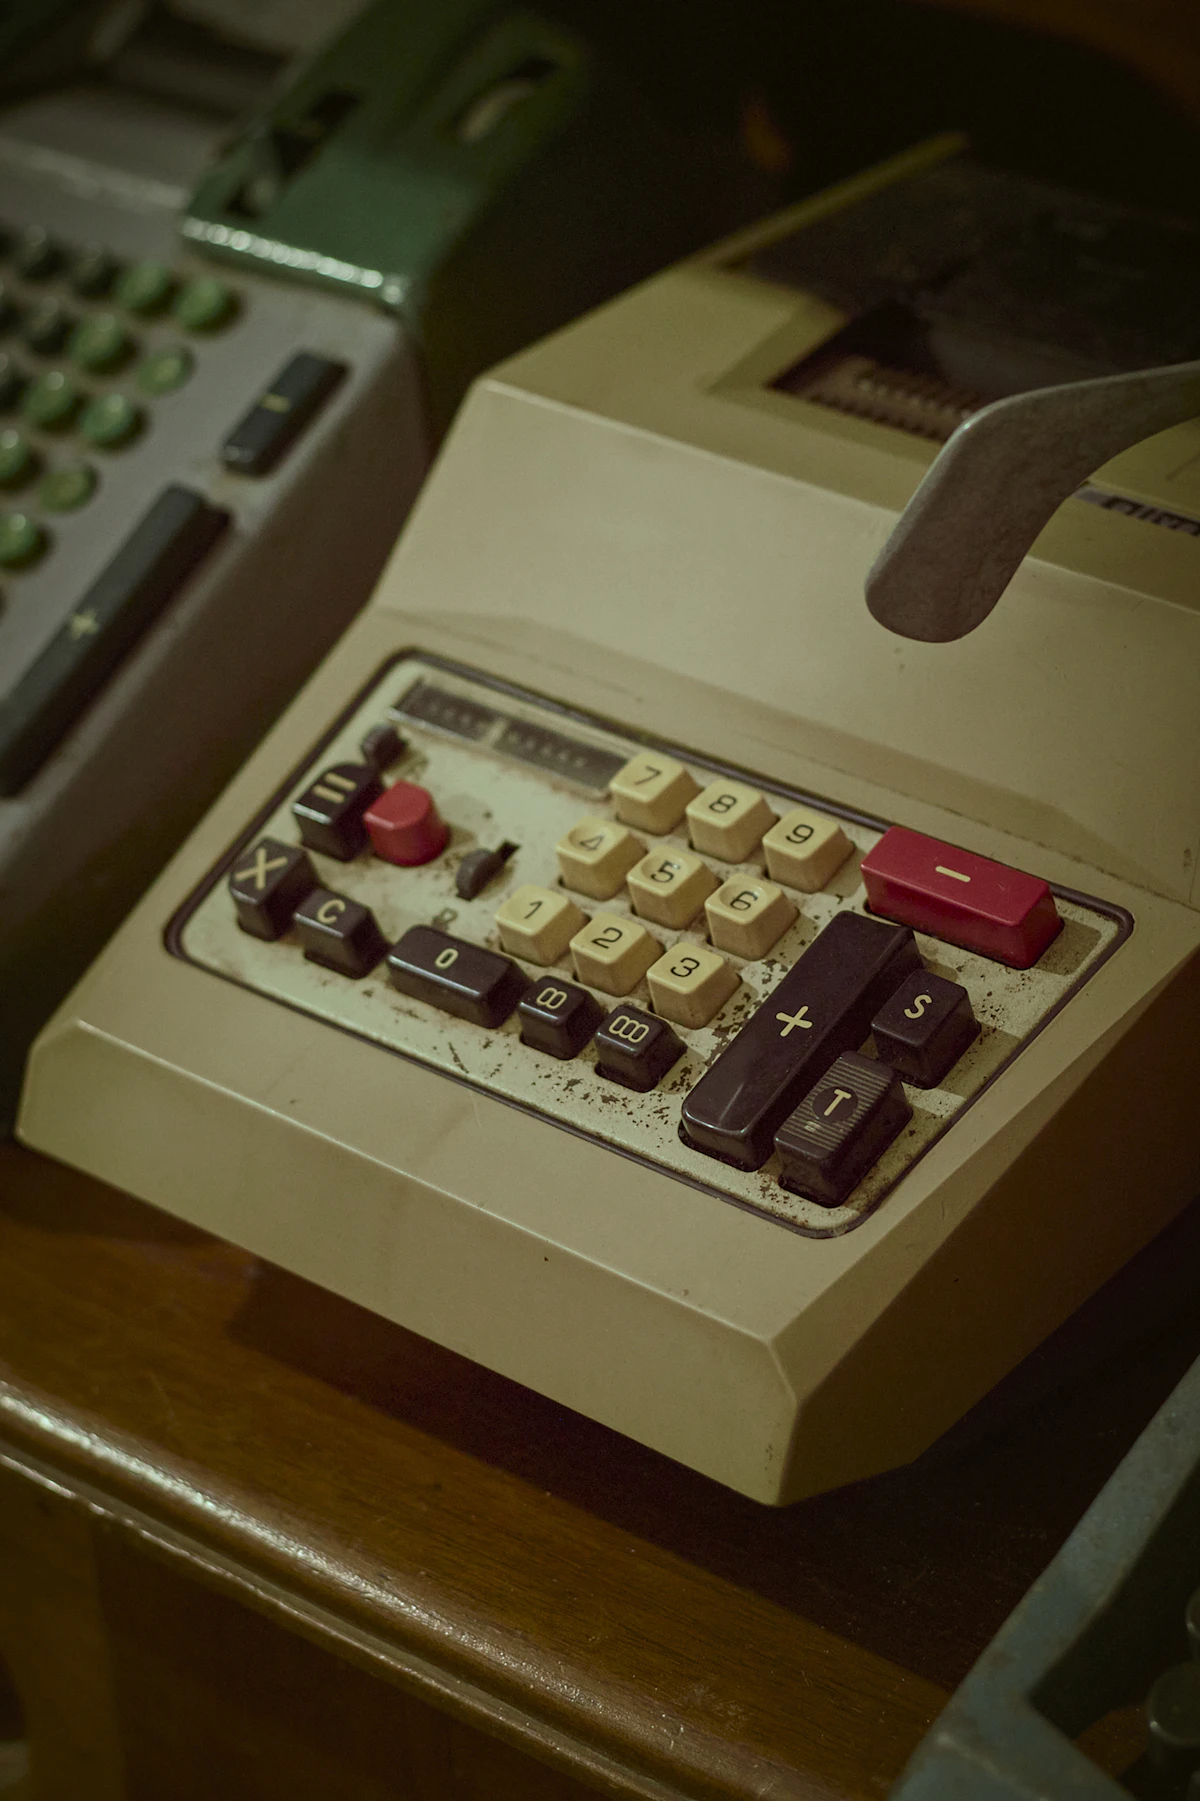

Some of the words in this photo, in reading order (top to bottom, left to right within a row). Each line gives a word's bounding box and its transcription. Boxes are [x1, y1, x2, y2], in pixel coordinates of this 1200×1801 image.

[634, 765, 662, 786] 7
[708, 794, 737, 814] 8
[578, 834, 605, 851] 4
[785, 824, 815, 846] 9
[650, 860, 680, 884] 5
[317, 899, 346, 924] C
[523, 900, 544, 920] 1
[729, 890, 758, 912] 6
[591, 926, 623, 949] 2
[670, 957, 700, 978] 3
[904, 994, 932, 1019] S
[824, 1089, 852, 1117] T
